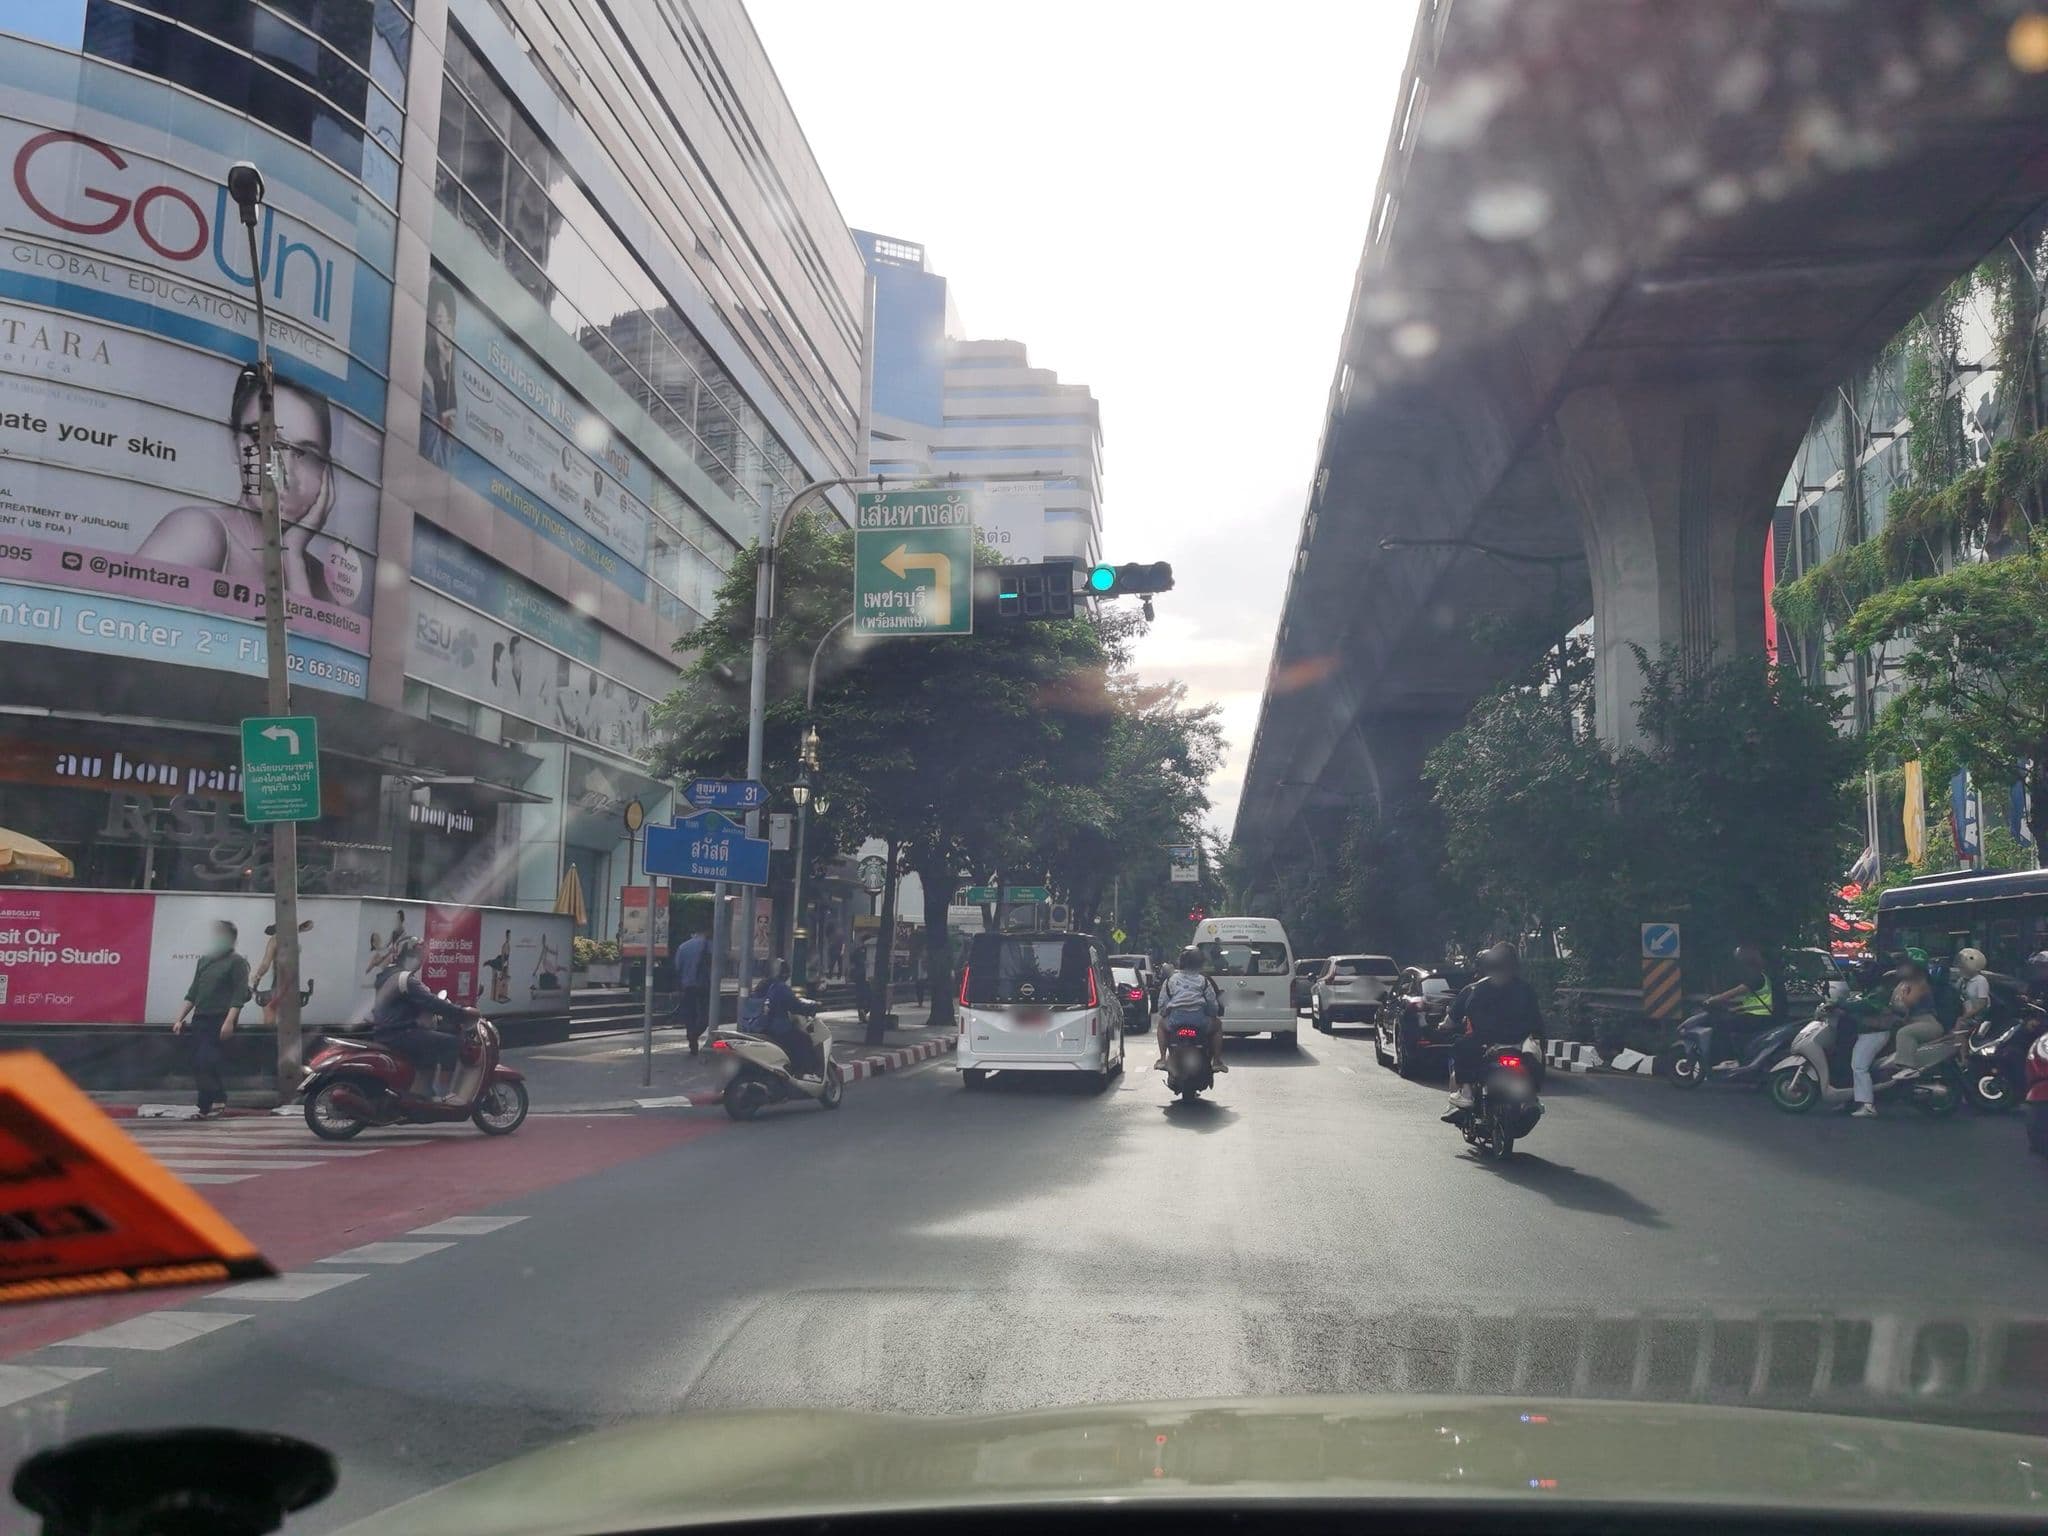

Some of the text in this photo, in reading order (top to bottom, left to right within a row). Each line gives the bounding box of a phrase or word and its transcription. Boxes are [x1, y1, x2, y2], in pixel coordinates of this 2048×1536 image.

[12, 245, 324, 358] GLOBAL EDUCATION ERVICE
[2, 318, 112, 366] TARA
[58, 423, 118, 448] your
[128, 437, 177, 462] skin
[65, 511, 78, 522] BY
[491, 479, 512, 501] and
[513, 494, 541, 526] many
[860, 494, 969, 527] เส้นทางลัด
[90, 556, 190, 589] @pimtara
[255, 592, 361, 635] ptara.estetica
[864, 585, 926, 614] เพชรบุรี
[77, 609, 183, 648] Center
[287, 654, 304, 672] 02
[309, 656, 332, 679] 662
[417, 611, 451, 649] RSU
[56, 754, 102, 778] au
[112, 752, 178, 786] bon
[696, 782, 758, 801] สุขุมวิท 31
[421, 805, 446, 827] bon
[446, 808, 474, 834] pain
[691, 836, 730, 861] สวัสดี
[691, 862, 728, 877] Sawatdi
[24, 928, 61, 945] Our
[61, 948, 121, 965] Studio
[14, 994, 26, 1005] at
[45, 992, 75, 1006] Floor
